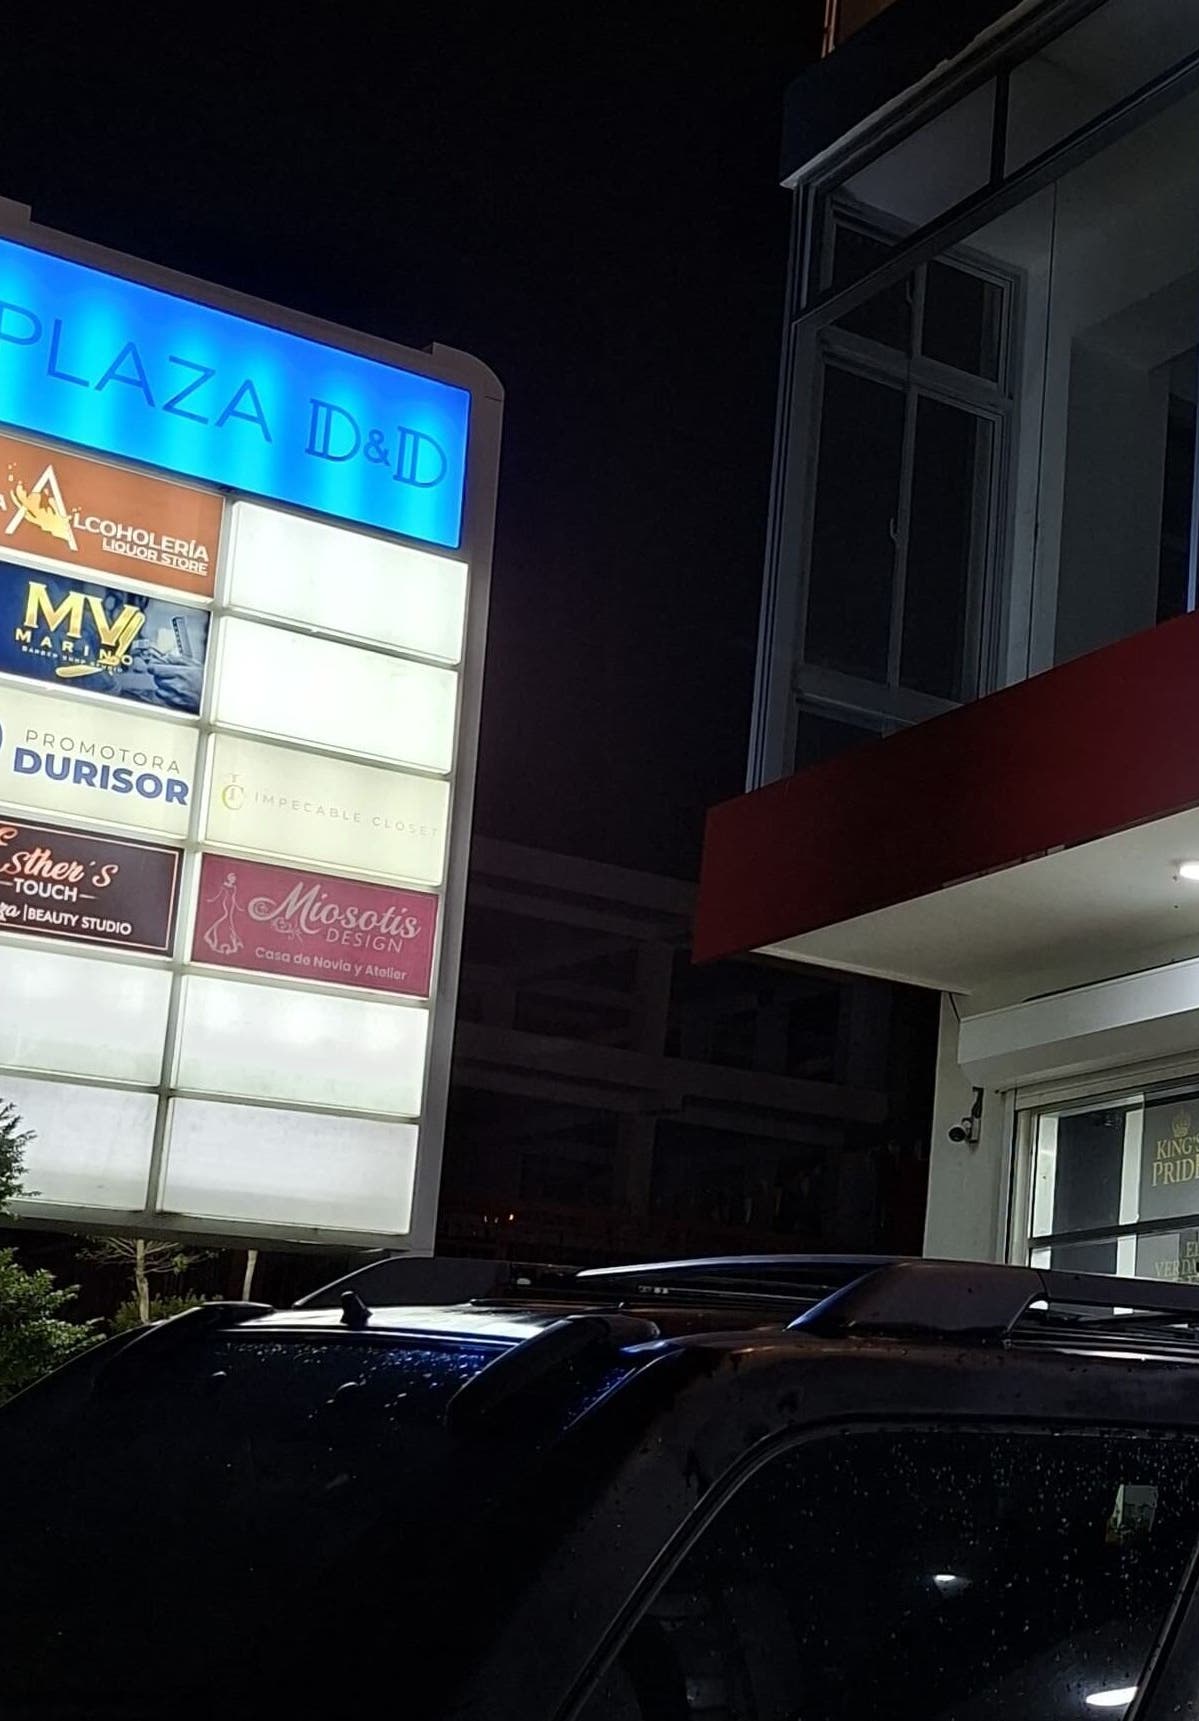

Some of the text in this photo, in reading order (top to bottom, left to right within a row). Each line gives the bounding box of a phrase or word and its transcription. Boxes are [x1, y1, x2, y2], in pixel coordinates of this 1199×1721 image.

[0, 304, 448, 489] PLAZA D&D
[102, 538, 209, 574] LIQUOR STORE
[24, 581, 140, 646] MV
[15, 628, 134, 665] MARINO
[26, 729, 181, 774] PROMOTORA
[13, 747, 189, 805] DURISOR
[255, 791, 438, 836] IMPECABLE CLOSET
[13, 877, 78, 902] TOUCH
[248, 881, 421, 939] Miosotis
[28, 907, 79, 927] BEAUTY
[81, 916, 132, 935] STUDIO
[325, 927, 403, 953] DESIGN
[255, 946, 408, 981] Casa de Novia y Atelier
